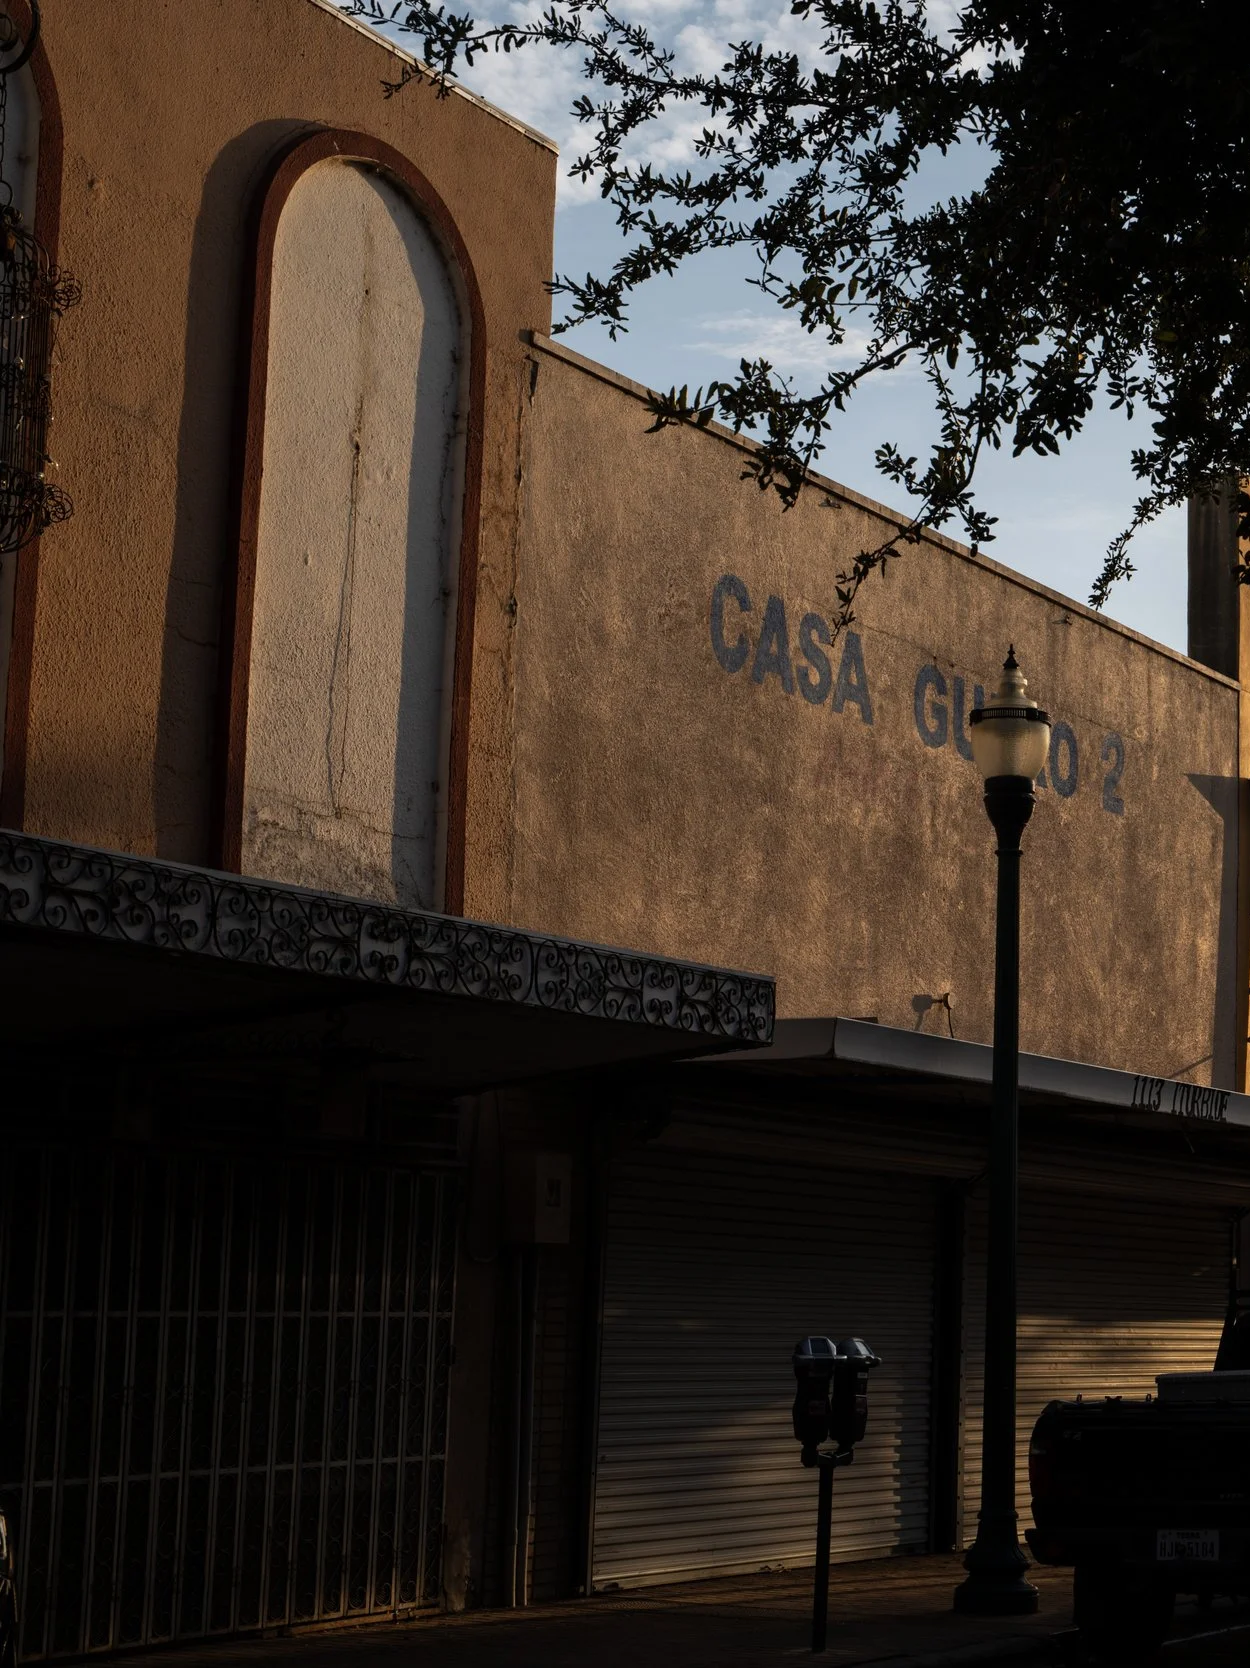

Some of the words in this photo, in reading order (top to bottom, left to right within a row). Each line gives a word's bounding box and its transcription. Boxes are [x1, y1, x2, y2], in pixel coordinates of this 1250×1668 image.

[711, 573, 873, 725] CASA
[914, 663, 1079, 799] GUO
[1100, 732, 1126, 816] 2
[1131, 1075, 1165, 1111] 1113
